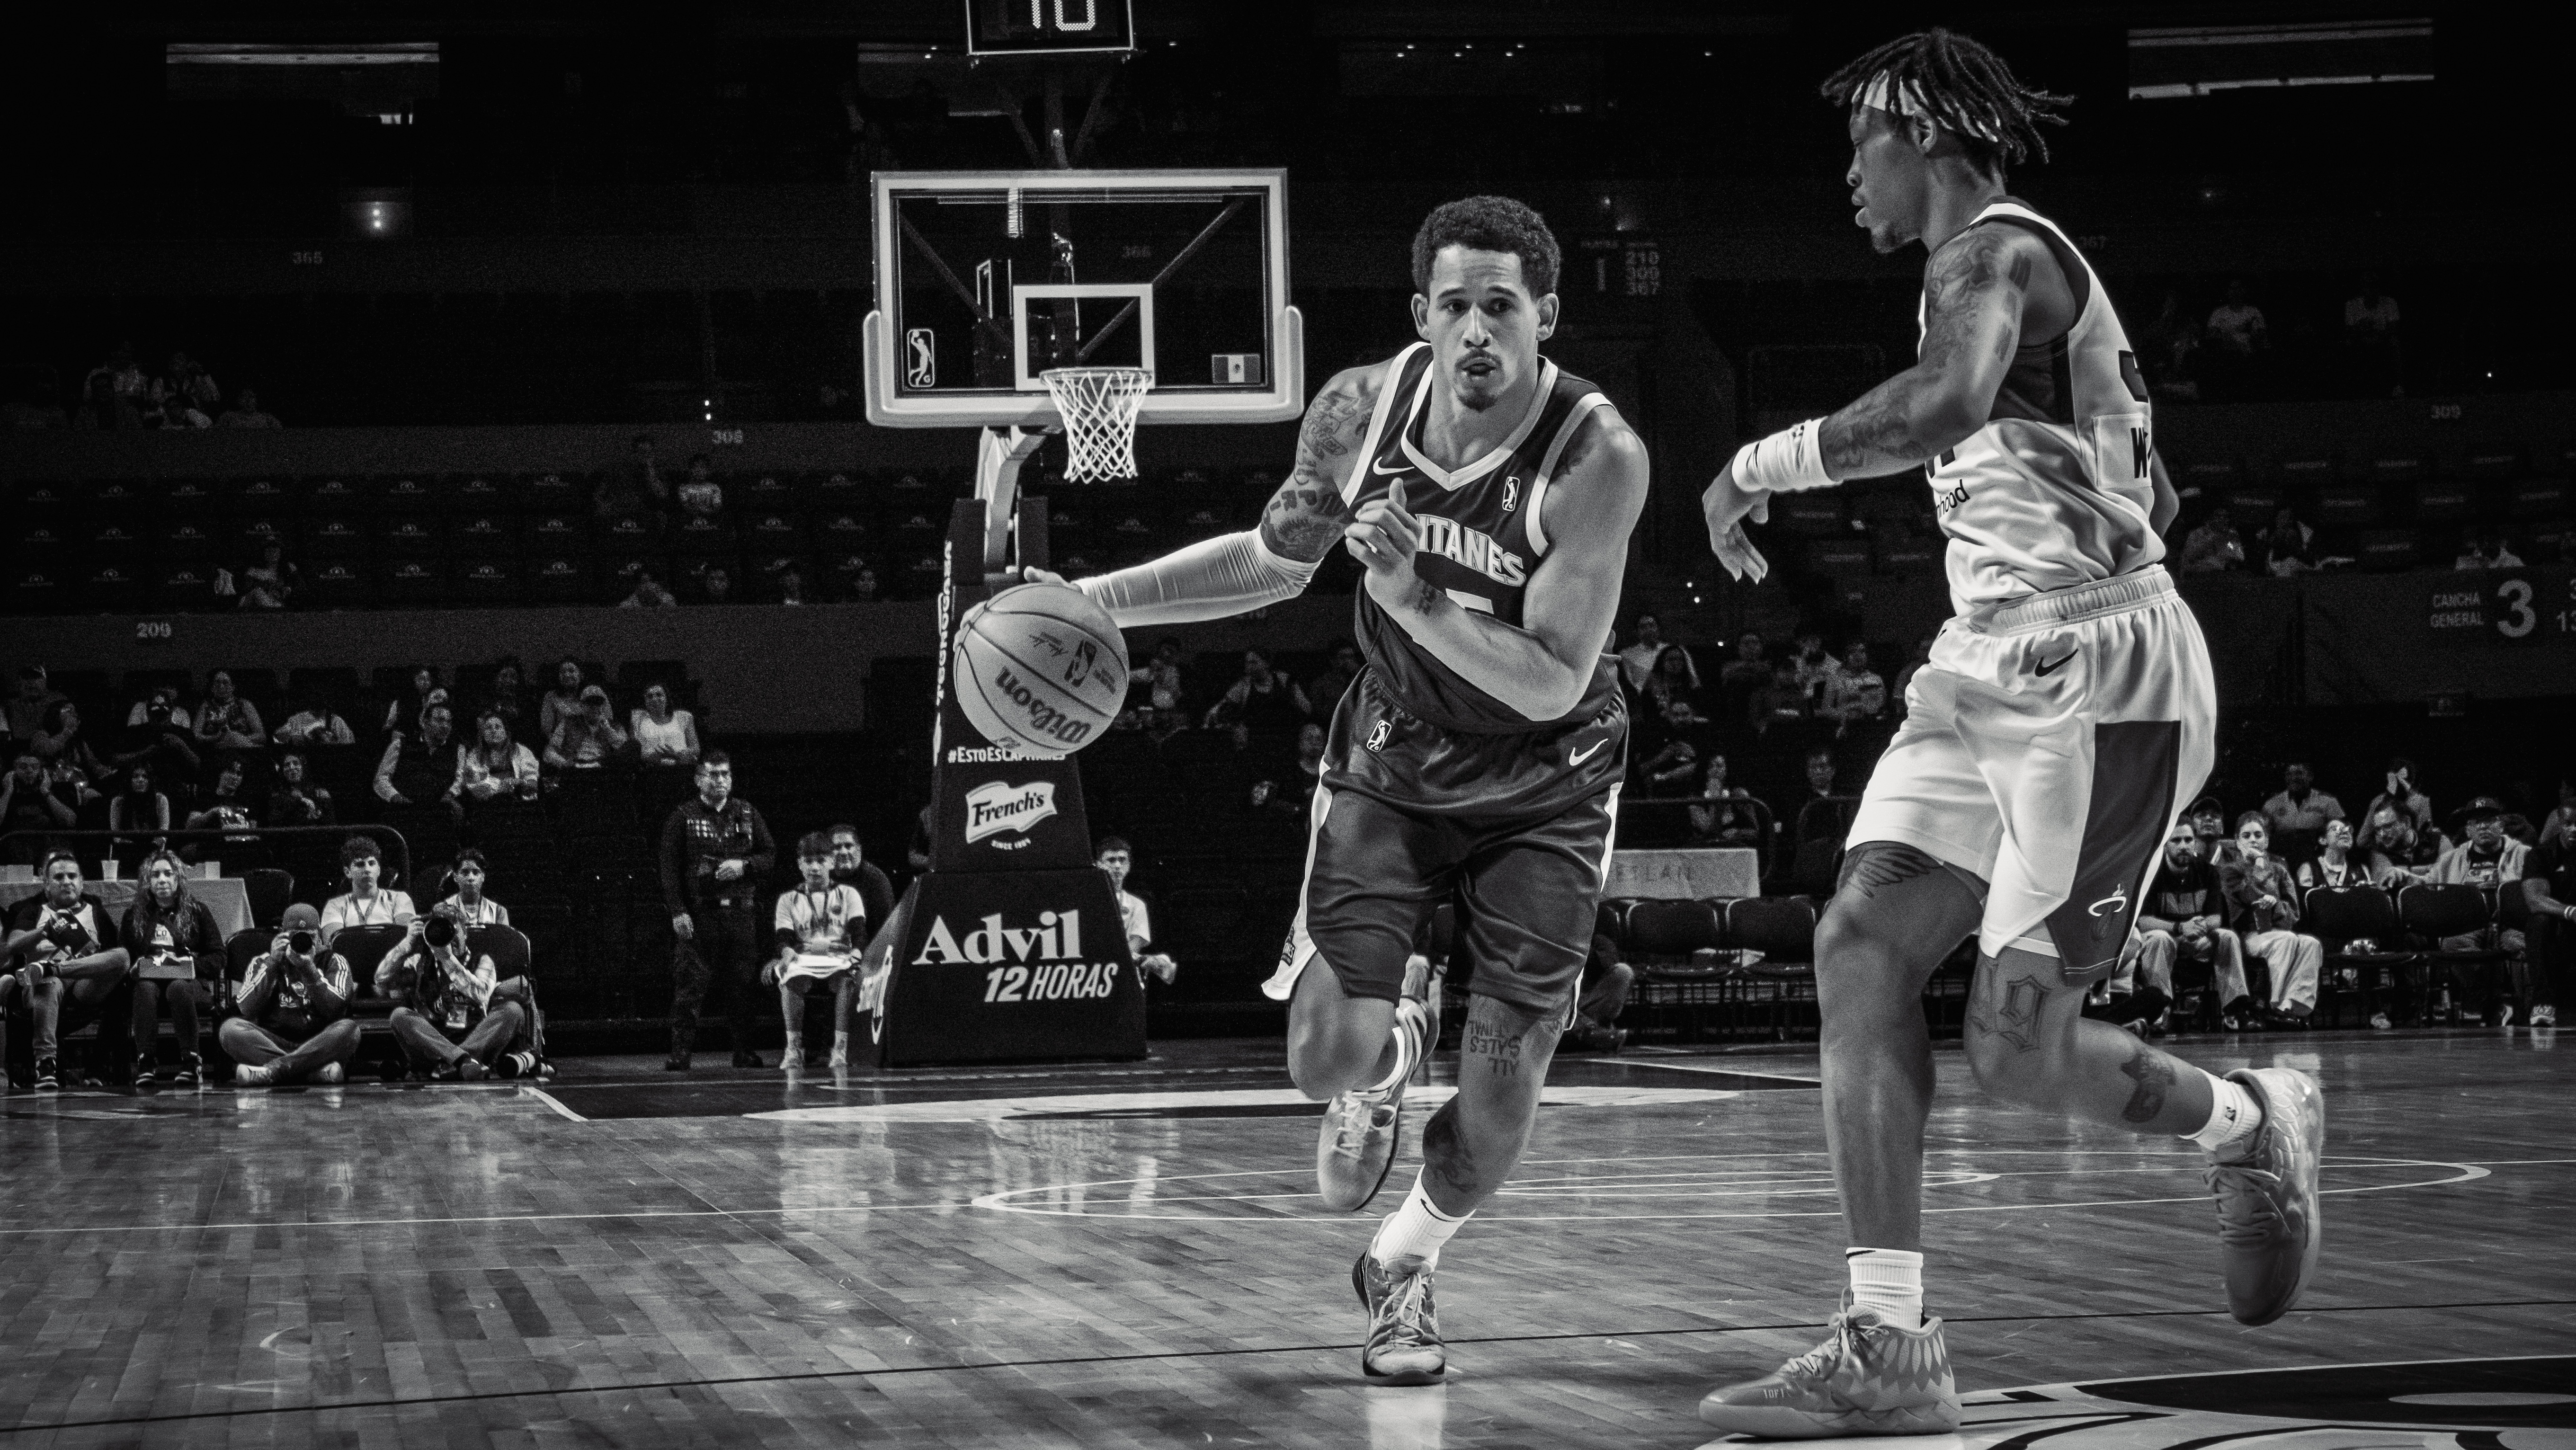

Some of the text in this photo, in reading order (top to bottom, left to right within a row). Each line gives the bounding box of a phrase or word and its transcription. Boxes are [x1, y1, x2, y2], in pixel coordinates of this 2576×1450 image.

[2433, 592, 2481, 608] CANCHA
[2497, 578, 2536, 638] 3
[136, 621, 171, 639] 209
[2430, 611, 2485, 628] GENERAL
[995, 665, 1092, 744] Wilson
[971, 791, 1044, 827] French's
[911, 908, 1083, 965] Advil
[984, 962, 1119, 1003] 12 HORAS
[1469, 1035, 1522, 1061] SALES
[1487, 1057, 1520, 1077] ALL
